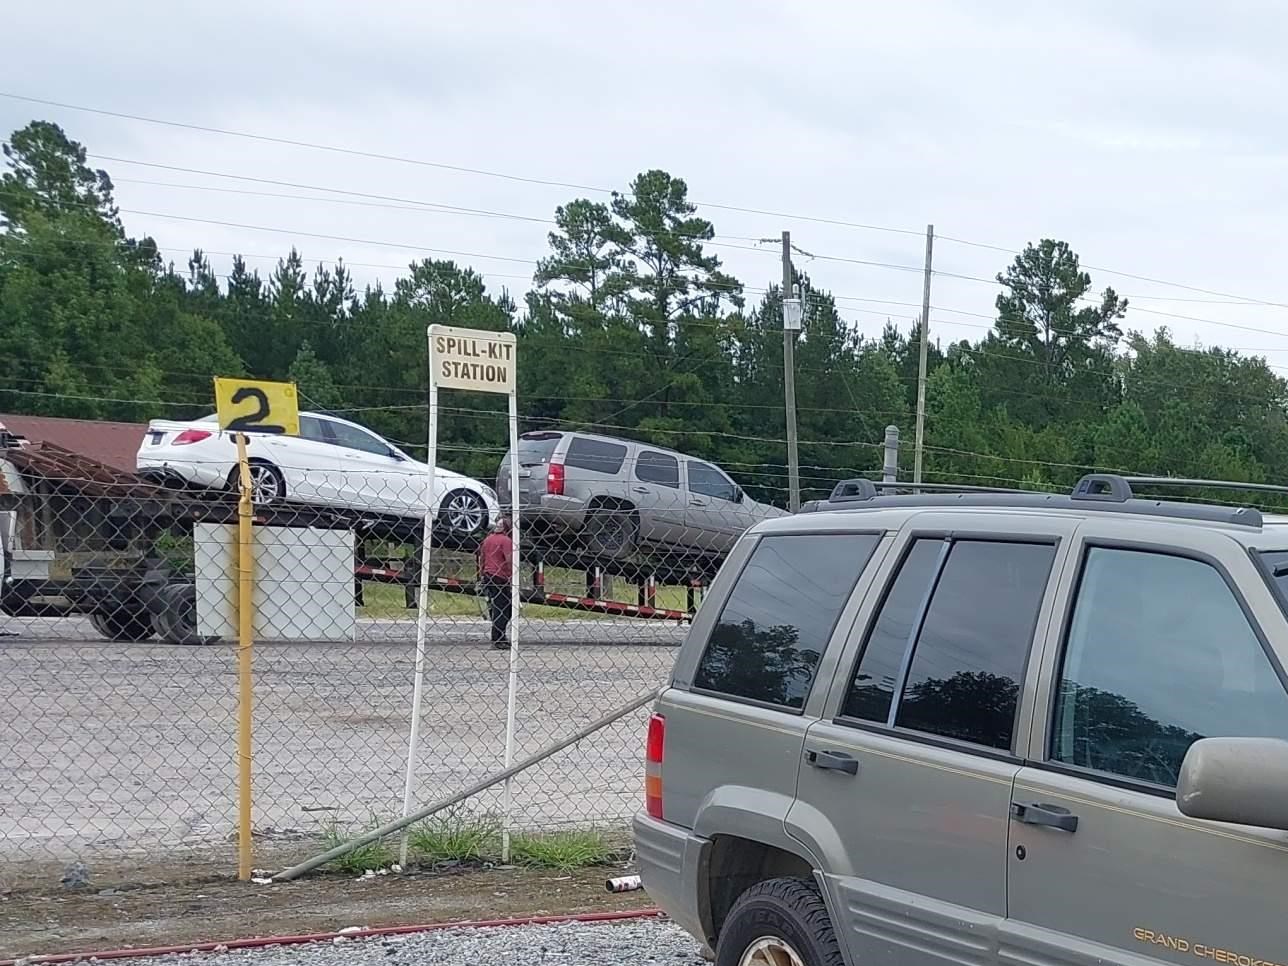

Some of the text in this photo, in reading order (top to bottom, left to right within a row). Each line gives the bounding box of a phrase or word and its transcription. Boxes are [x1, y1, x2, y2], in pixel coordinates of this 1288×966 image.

[436, 336, 512, 361] SPILL-KIT
[441, 360, 507, 384] STATION
[223, 387, 287, 434] 2
[1133, 927, 1190, 952] GRAND
